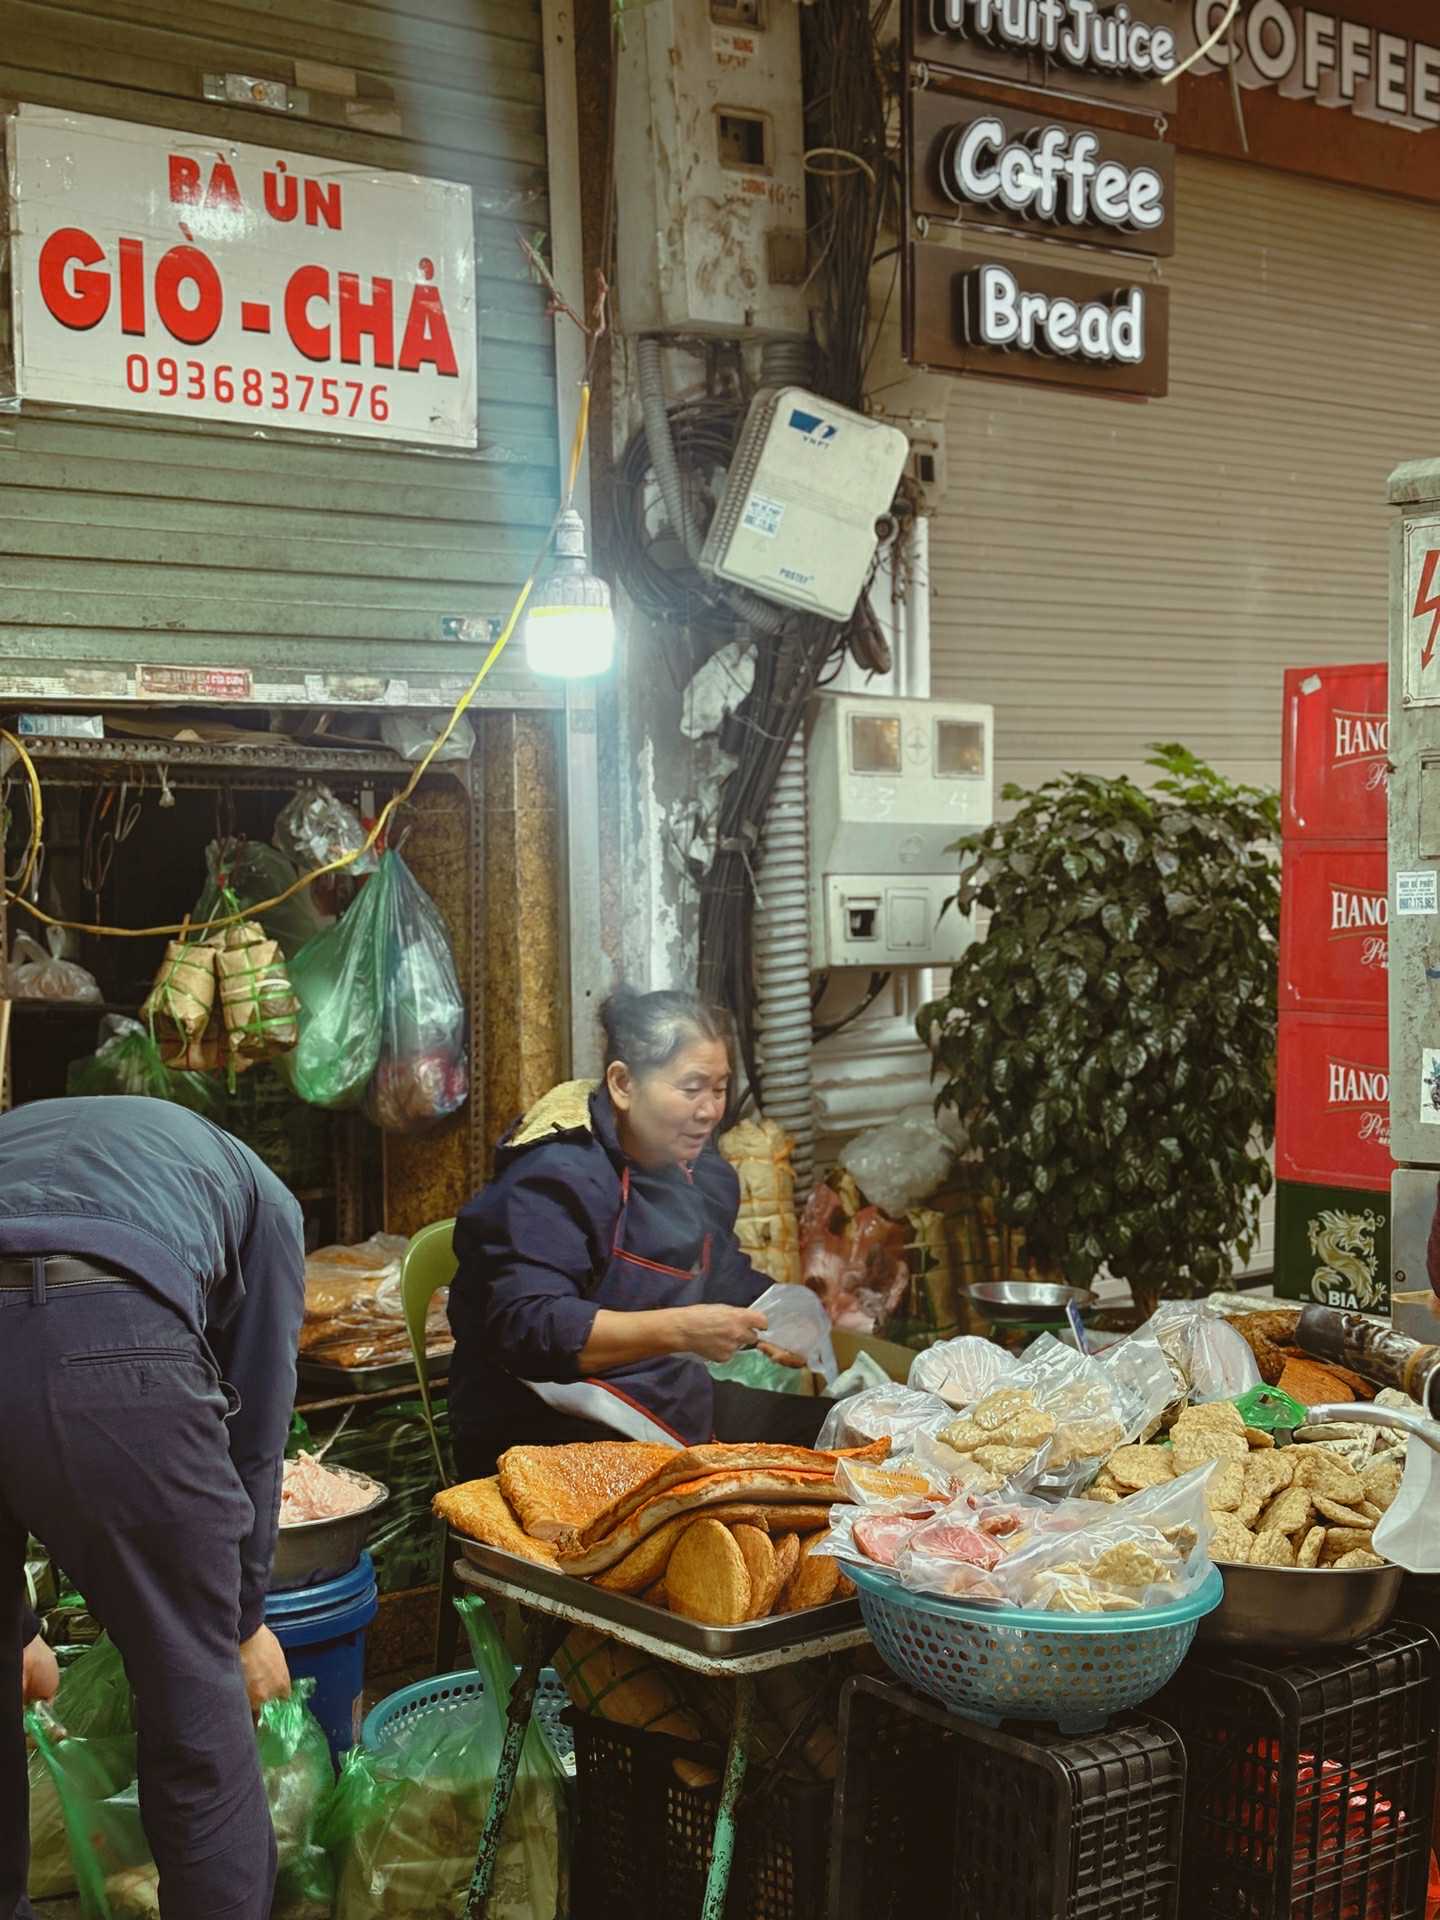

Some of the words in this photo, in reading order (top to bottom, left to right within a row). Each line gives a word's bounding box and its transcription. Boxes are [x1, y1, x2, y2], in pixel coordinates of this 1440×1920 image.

[1193, 0, 1440, 119] COFFEE
[168, 152, 243, 213] BÀ
[263, 159, 342, 230] ỦN
[957, 117, 1164, 228] Coffee
[38, 222, 223, 346] GIÒ
[284, 257, 459, 378] CHẢ
[981, 265, 1145, 364] Bread
[126, 353, 390, 421] 0936837576
[1328, 1290, 1358, 1310] BIA
